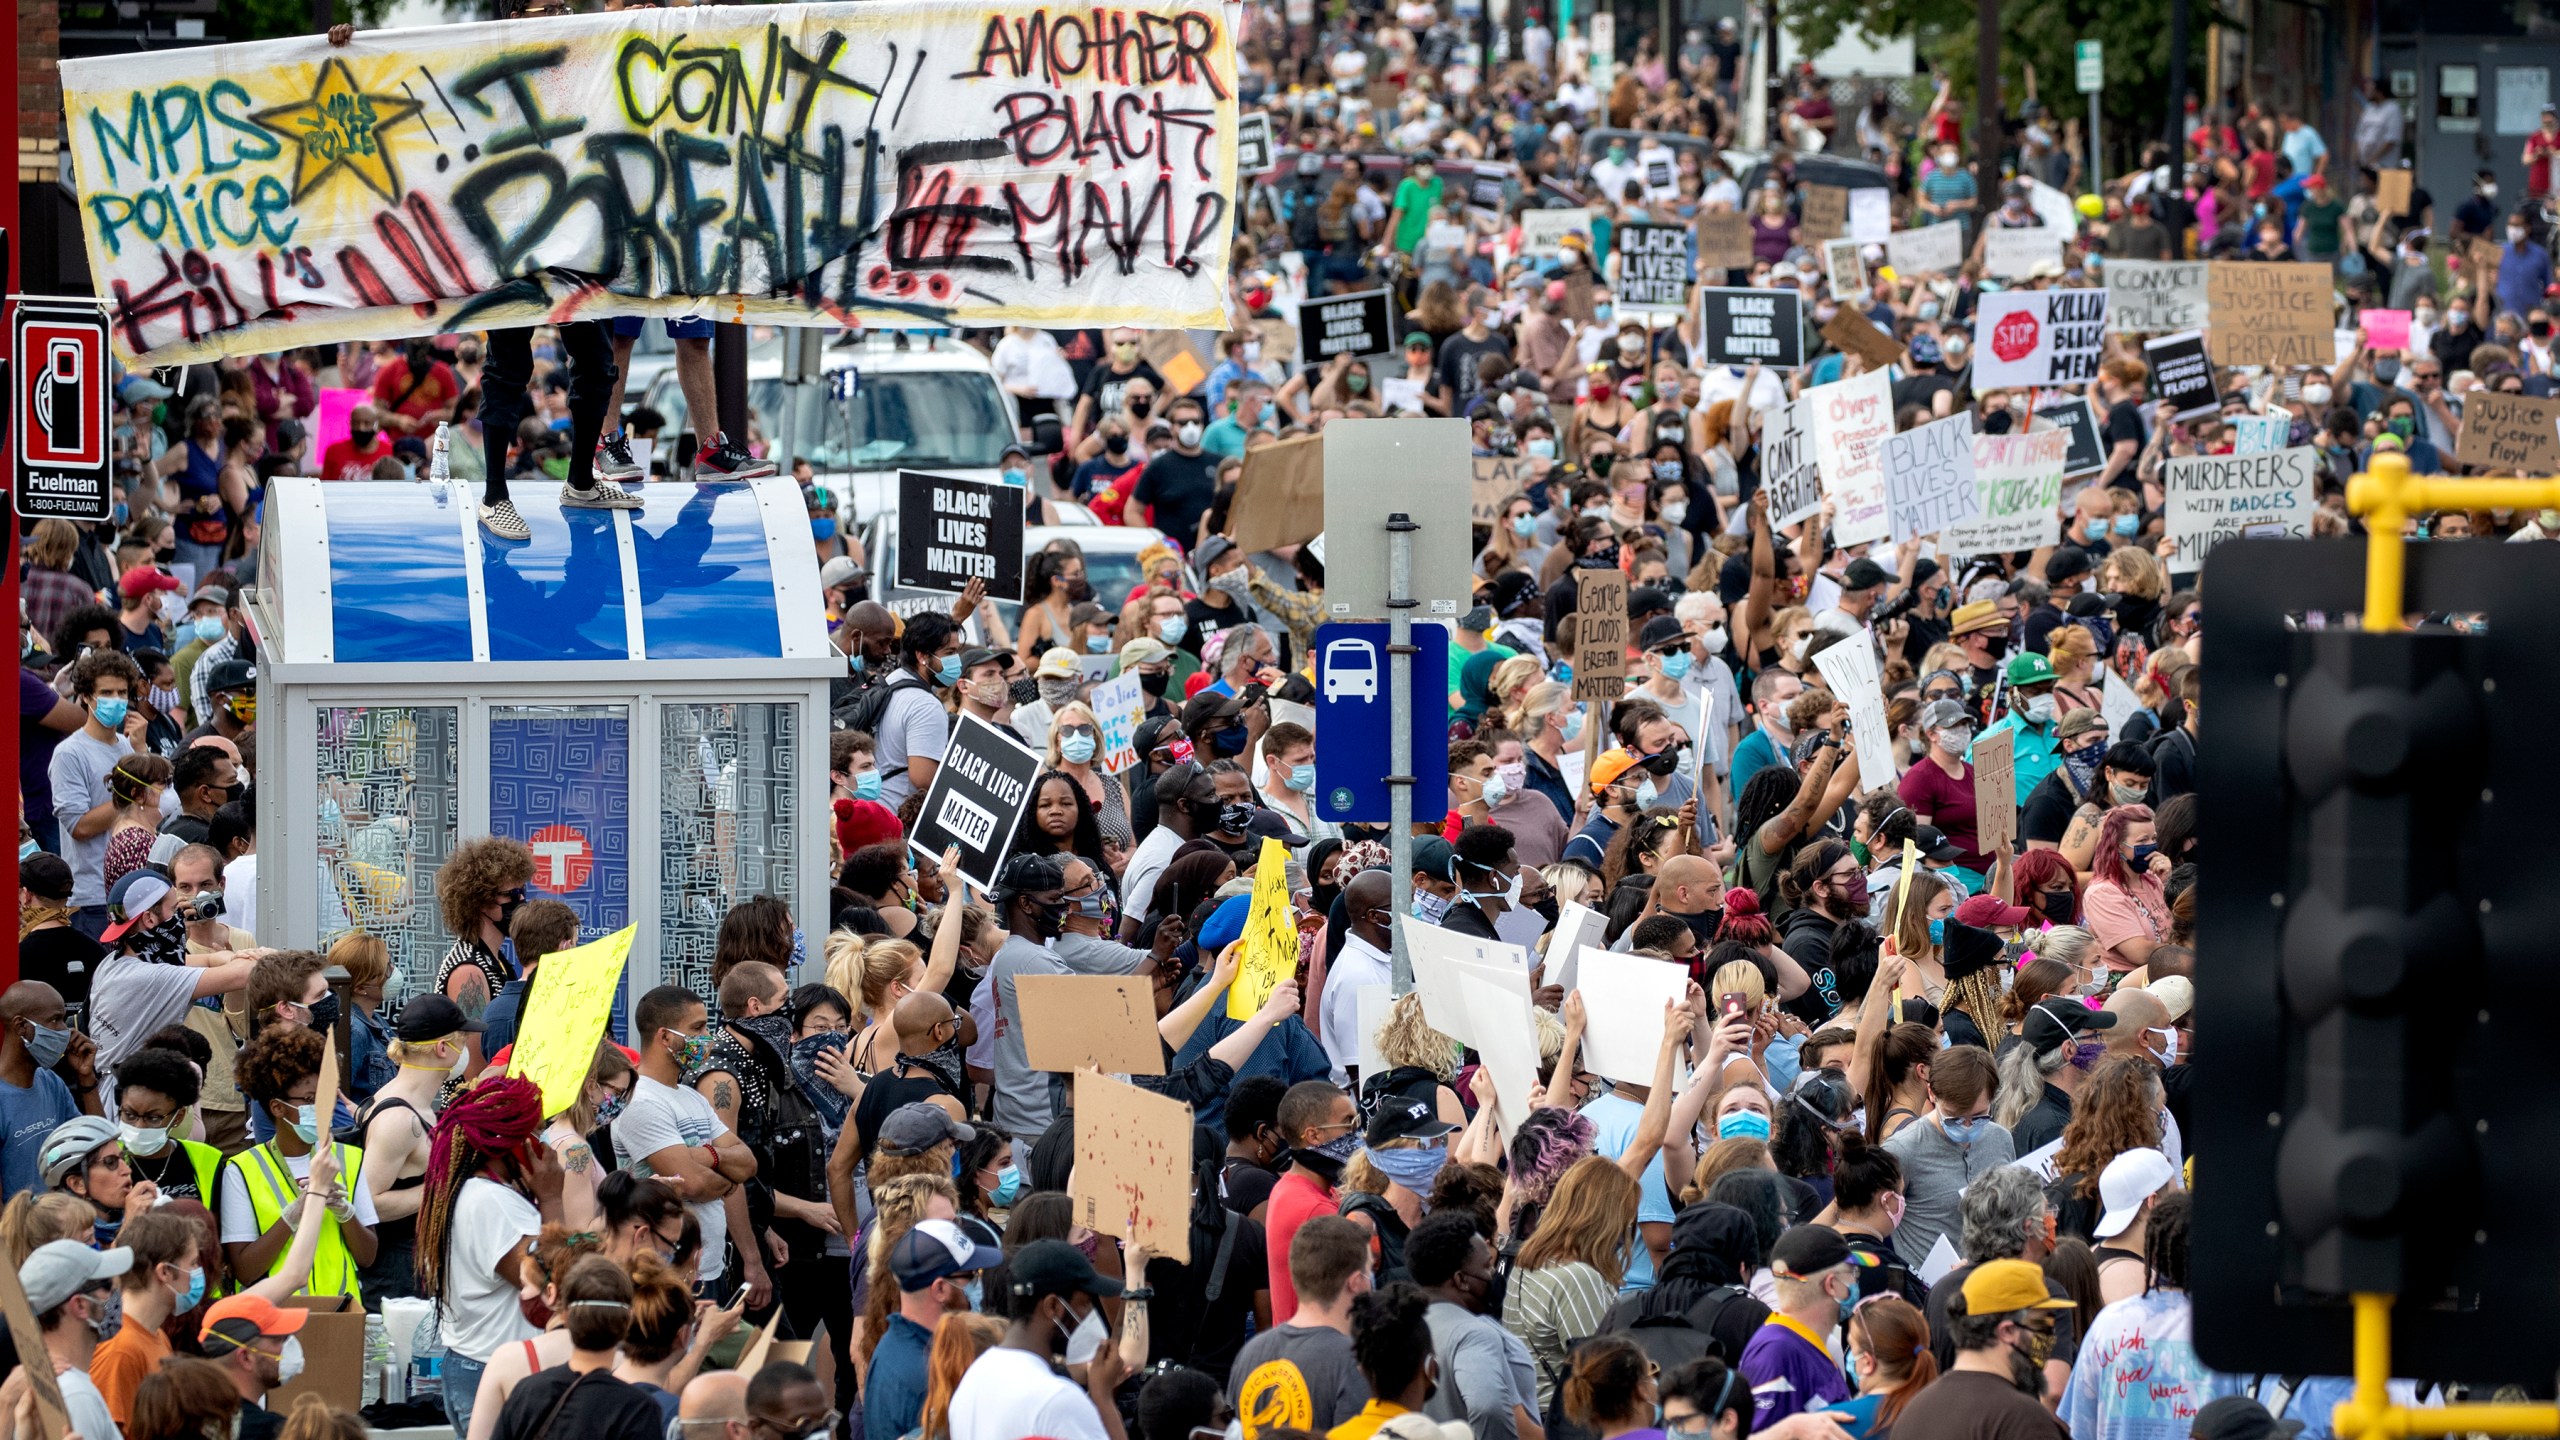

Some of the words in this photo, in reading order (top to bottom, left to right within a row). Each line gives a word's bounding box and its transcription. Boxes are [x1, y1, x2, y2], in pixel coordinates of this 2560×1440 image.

[89, 79, 282, 189] MPLS
[994, 90, 1217, 182] BLACK
[1620, 227, 1687, 255] BLACK
[1621, 254, 1687, 279] LIVES
[2114, 266, 2201, 290] CONVICT
[2218, 267, 2282, 289] TRUTH
[1620, 279, 1686, 304] MATTER
[2143, 291, 2172, 308] THE
[2221, 291, 2317, 313] JUSTICE
[1320, 300, 1367, 323] BLACK
[1728, 297, 1776, 317] BLACK
[2116, 303, 2196, 328] POLICE
[1325, 317, 1365, 338] LIVES
[1732, 316, 1773, 336] LIVES
[2239, 312, 2300, 331] WILL
[1319, 331, 1373, 355] MATTER
[1725, 336, 1781, 357] MATTER
[1998, 322, 2035, 347] STOP
[2054, 324, 2105, 350] BLACK
[2225, 333, 2328, 364] PREVAIL
[2049, 351, 2101, 381] MEN
[2158, 361, 2207, 382] GEORGE
[2163, 375, 2208, 396] FLOYD
[1783, 403, 1797, 436] I
[1889, 415, 1971, 477] BLACK
[28, 471, 98, 493] Fuelman
[1890, 458, 1958, 506] LIVES
[2171, 454, 2304, 492] MURDERERS
[29, 498, 99, 512] 1-800-FUELMAN
[933, 487, 992, 519] BLACK
[1893, 479, 1981, 536] MATTER
[2185, 499, 2225, 514] WITH
[2229, 490, 2297, 513] BADGES
[937, 518, 987, 548] LIVES
[2213, 517, 2241, 528] ARE
[927, 546, 996, 580] MATTER
[1579, 576, 1623, 616] George
[1583, 649, 1618, 672] BREATH
[1092, 684, 1138, 714] Police
[1576, 676, 1625, 700] MATTERED
[1101, 713, 1127, 732] are
[1104, 729, 1129, 751] the
[1103, 747, 1137, 773] VIR
[947, 743, 991, 787] BLACK
[986, 766, 1024, 808] LIVES
[942, 797, 990, 845] MATTER
[2094, 1326, 2150, 1369] Wish
[2173, 1401, 2199, 1420] Her
